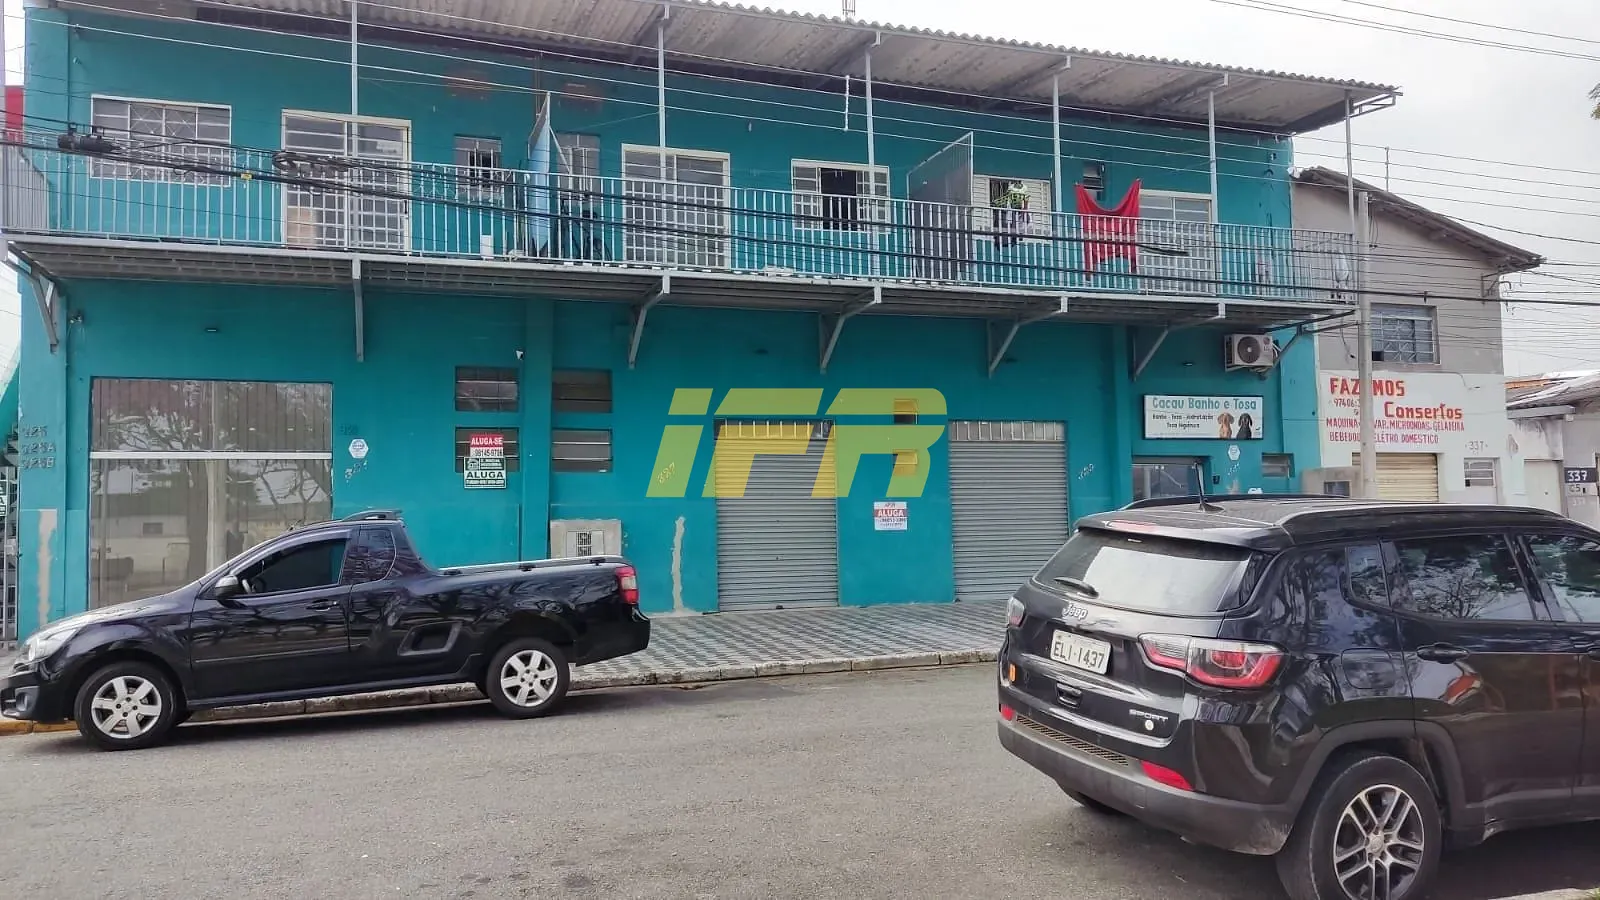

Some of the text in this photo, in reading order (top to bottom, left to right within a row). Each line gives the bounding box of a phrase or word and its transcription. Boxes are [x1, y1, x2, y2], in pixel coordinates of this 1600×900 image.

[1329, 377, 1405, 397] FAZMOS
[1152, 397, 1257, 410] Cacau Banho e Tosa
[471, 437, 504, 446] ALUGA-SE
[1329, 432, 1361, 442] BEBEDOU
[1468, 440, 1484, 452] 337
[466, 471, 504, 479] ALUGA
[1567, 470, 1588, 482] 337
[877, 509, 904, 517] ALUGA
[1062, 603, 1089, 621] Jeep
[1053, 640, 1105, 670] ELI-1437
[1128, 708, 1169, 723] SPORT
